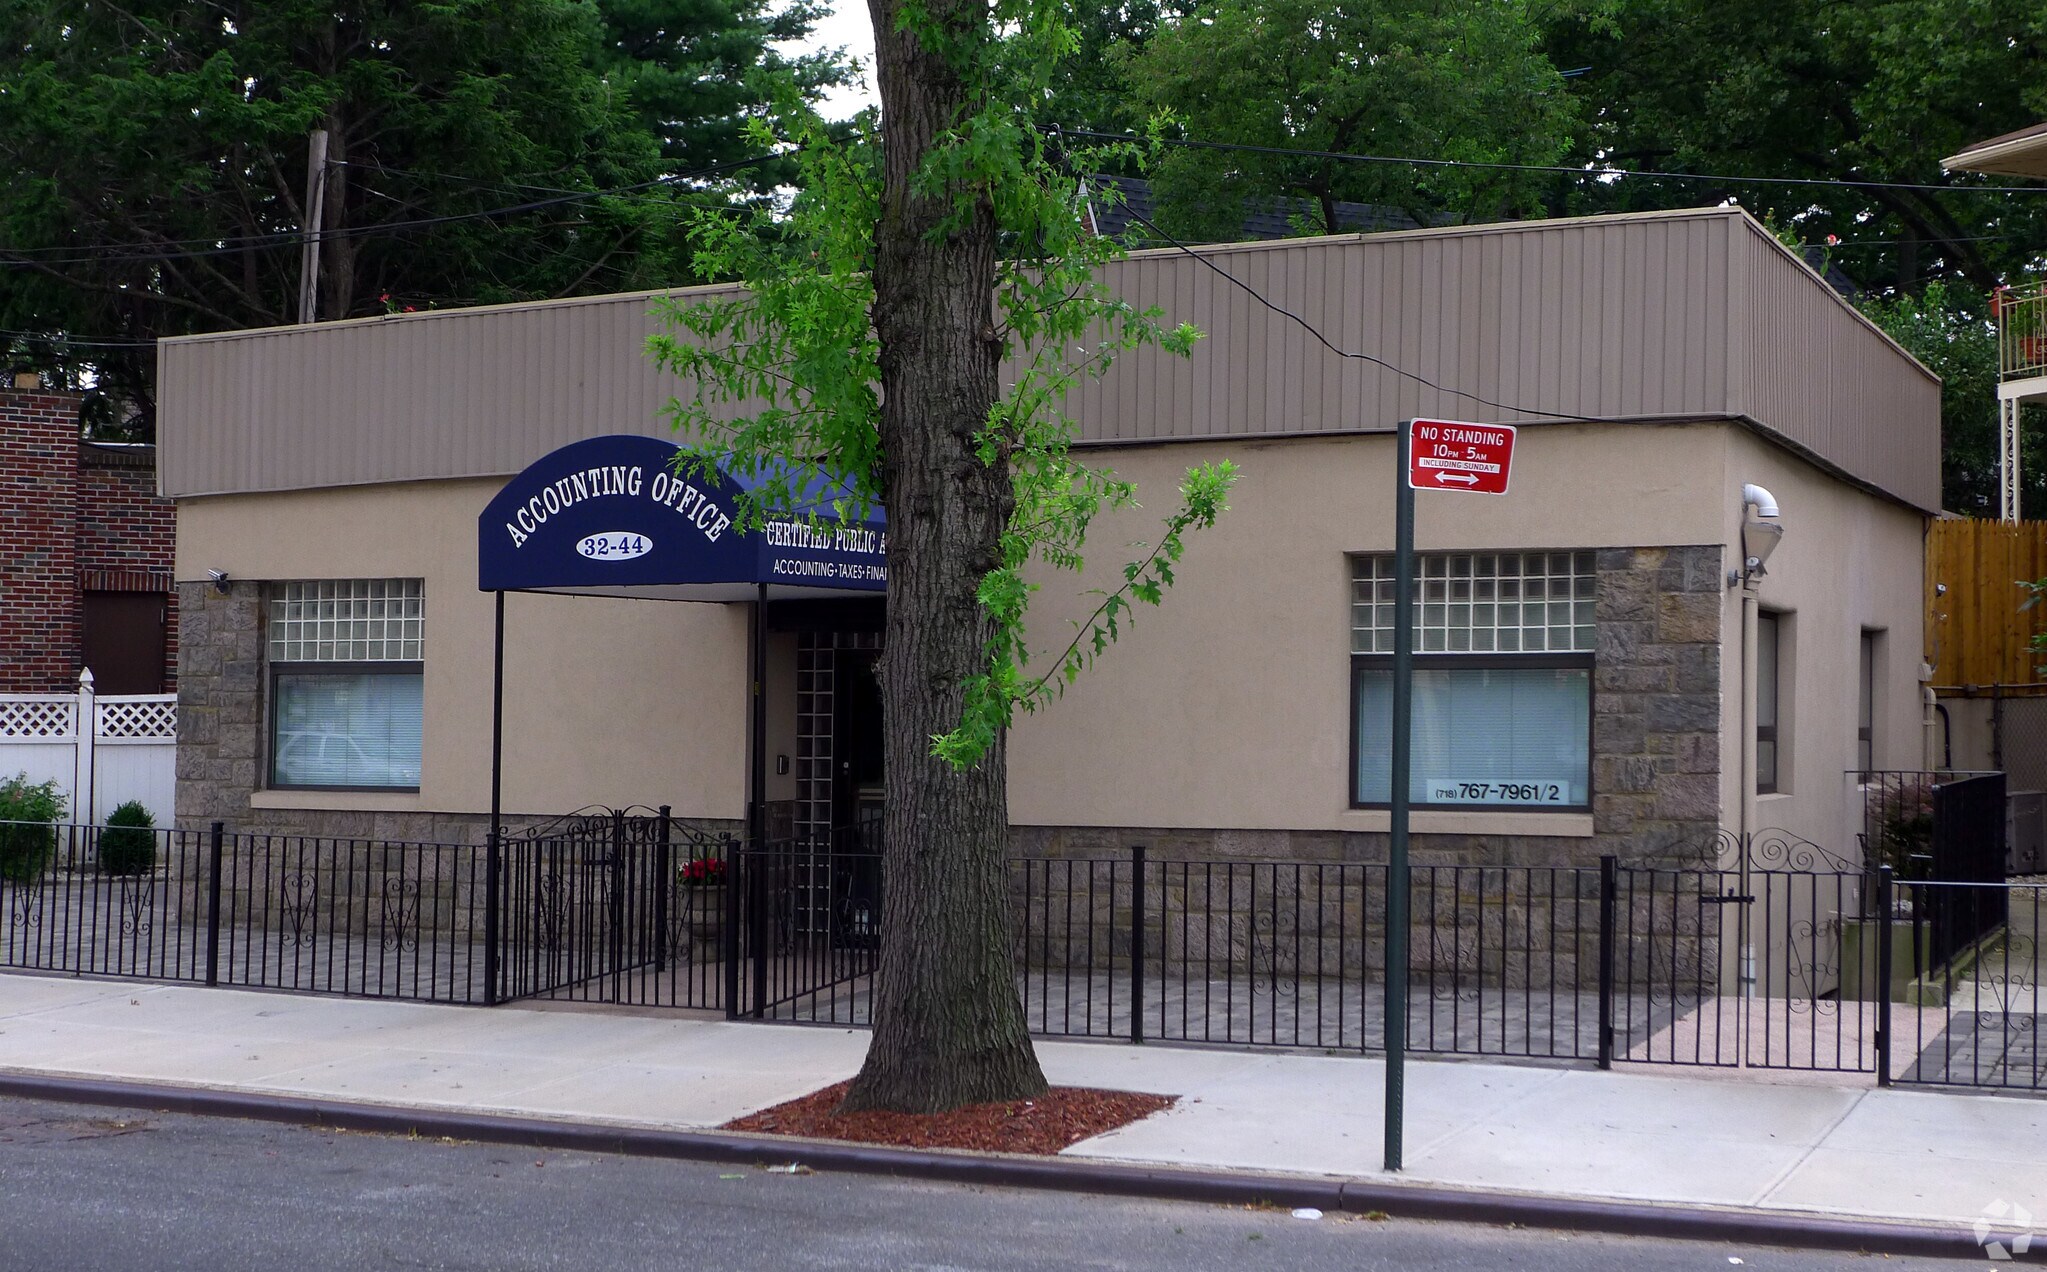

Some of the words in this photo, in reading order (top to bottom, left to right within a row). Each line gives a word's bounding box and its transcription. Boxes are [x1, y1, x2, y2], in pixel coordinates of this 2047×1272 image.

[1420, 426, 1438, 440] NO
[1442, 428, 1505, 446] STANDING
[1423, 459, 1462, 469] INCLUDING
[1463, 462, 1495, 472] SUNDAY
[504, 466, 643, 549] ACCOUNTING
[651, 472, 731, 544] OFFICE
[583, 535, 644, 557] 32-44
[766, 520, 831, 550] CERTIFIED
[835, 526, 876, 554] PUBLIC
[1436, 789, 1458, 800] (718)
[1459, 783, 1560, 802] 767-7961/2
